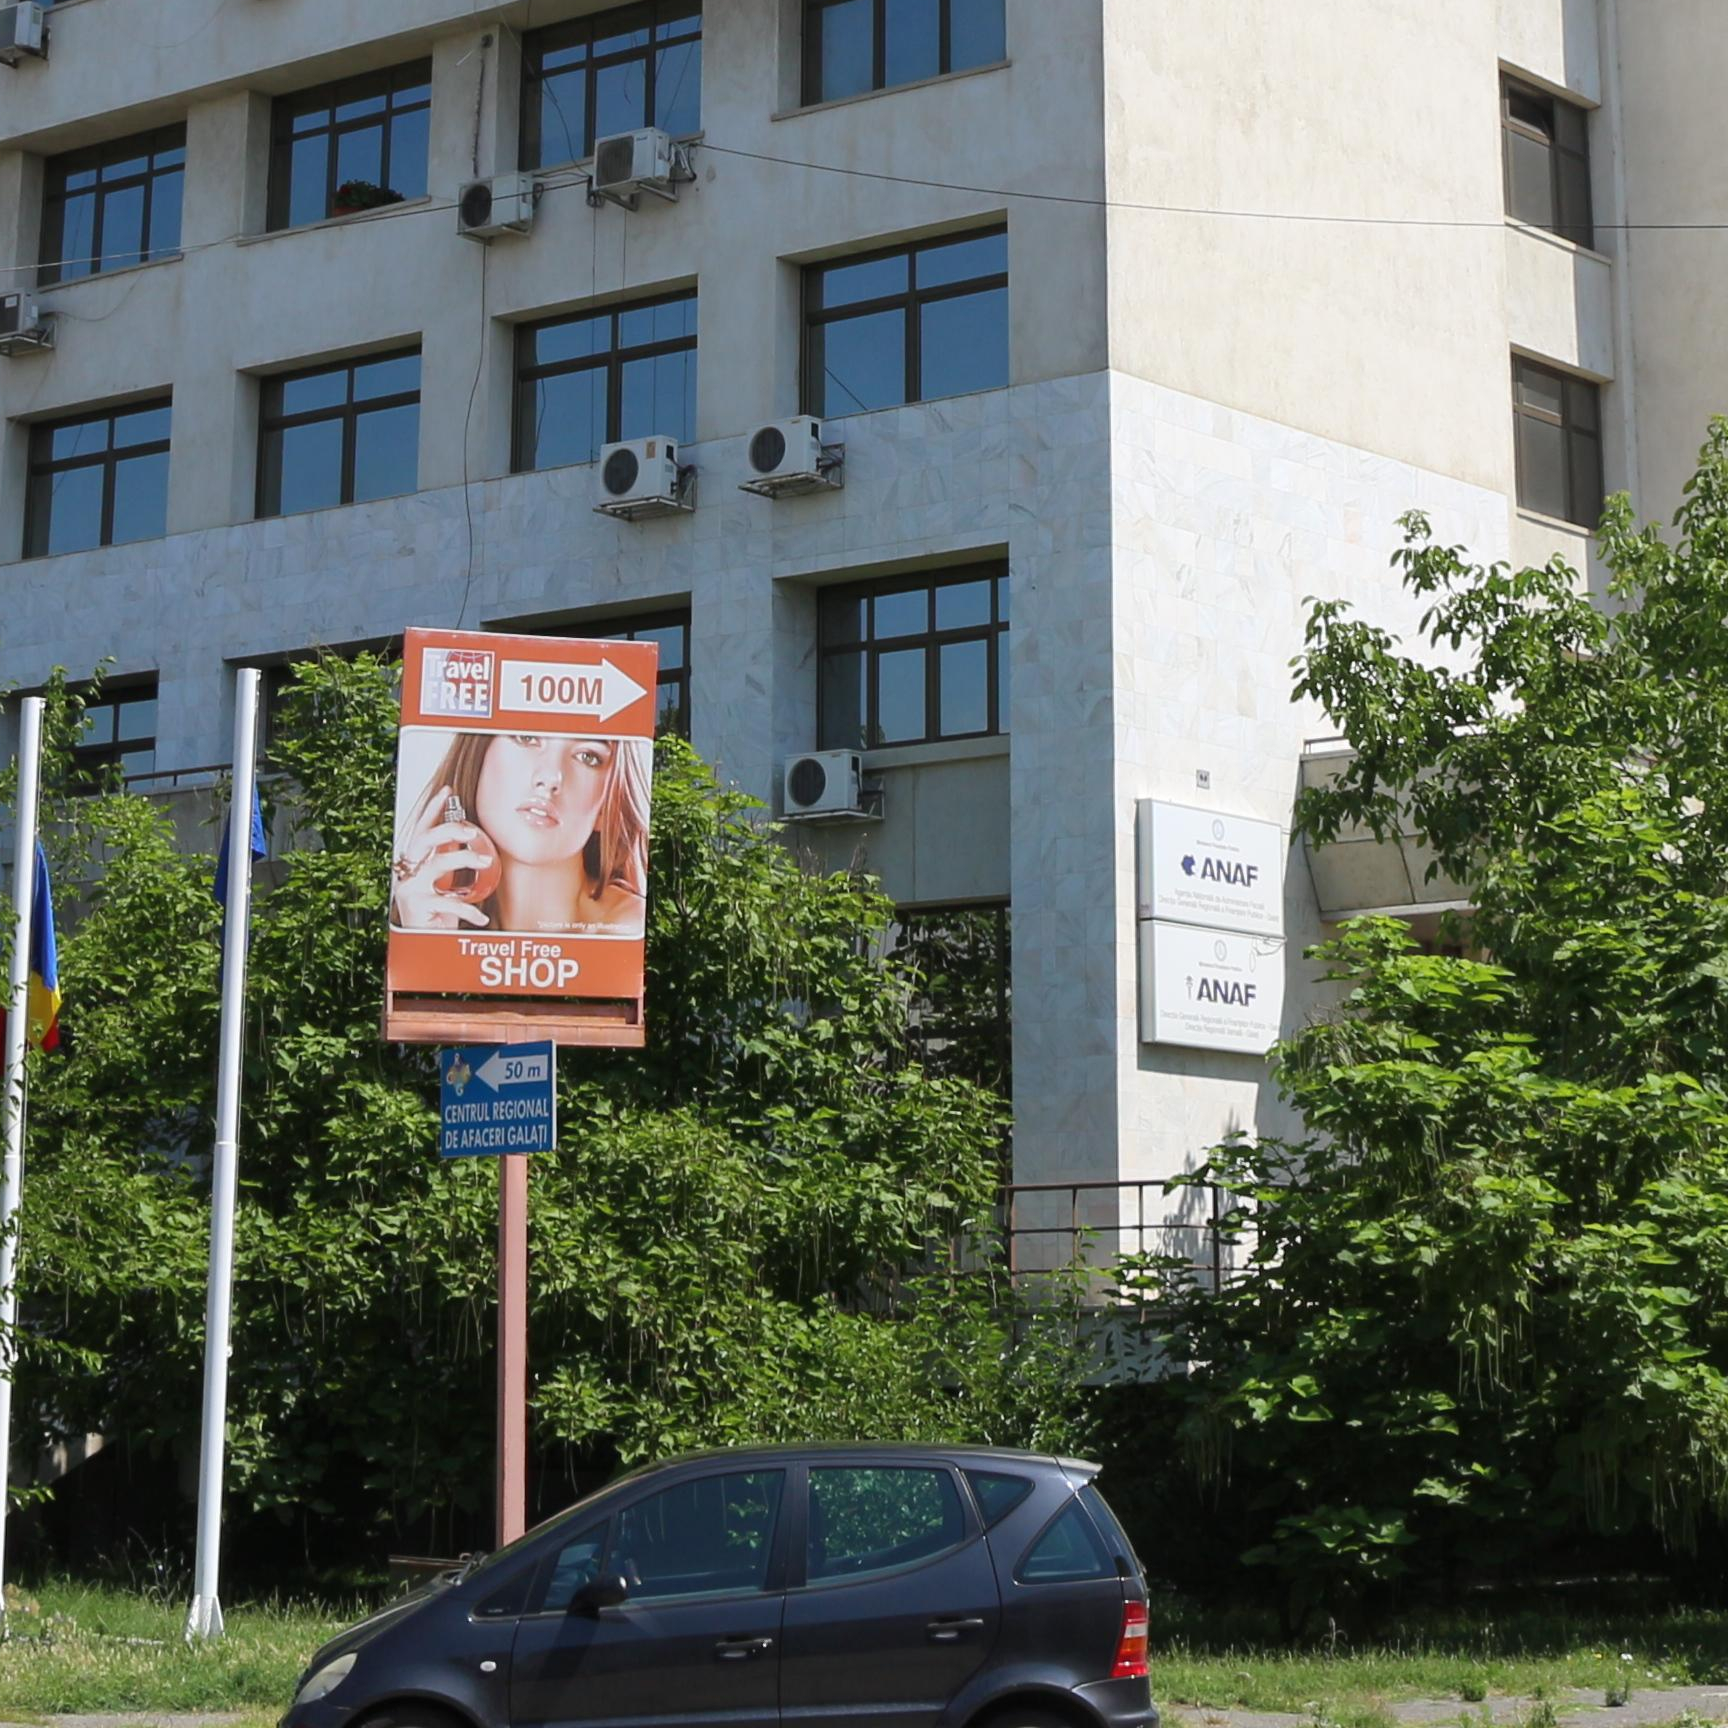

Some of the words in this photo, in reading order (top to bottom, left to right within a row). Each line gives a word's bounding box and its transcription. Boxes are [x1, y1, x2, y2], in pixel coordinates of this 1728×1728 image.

[426, 654, 491, 681] Travel
[424, 680, 489, 712] FREE
[520, 674, 603, 706] 100M
[1200, 857, 1259, 888] ANAF
[458, 939, 515, 956] Travel
[521, 941, 562, 958] Free
[480, 956, 579, 988] SHOP
[1197, 977, 1256, 1007] ANAF
[504, 1061, 524, 1079] 50
[527, 1066, 540, 1078] m
[444, 1102, 490, 1123] CENTRUL
[492, 1098, 549, 1121] REGIONAL
[445, 1129, 458, 1149] DE
[460, 1126, 505, 1148] AFACERI
